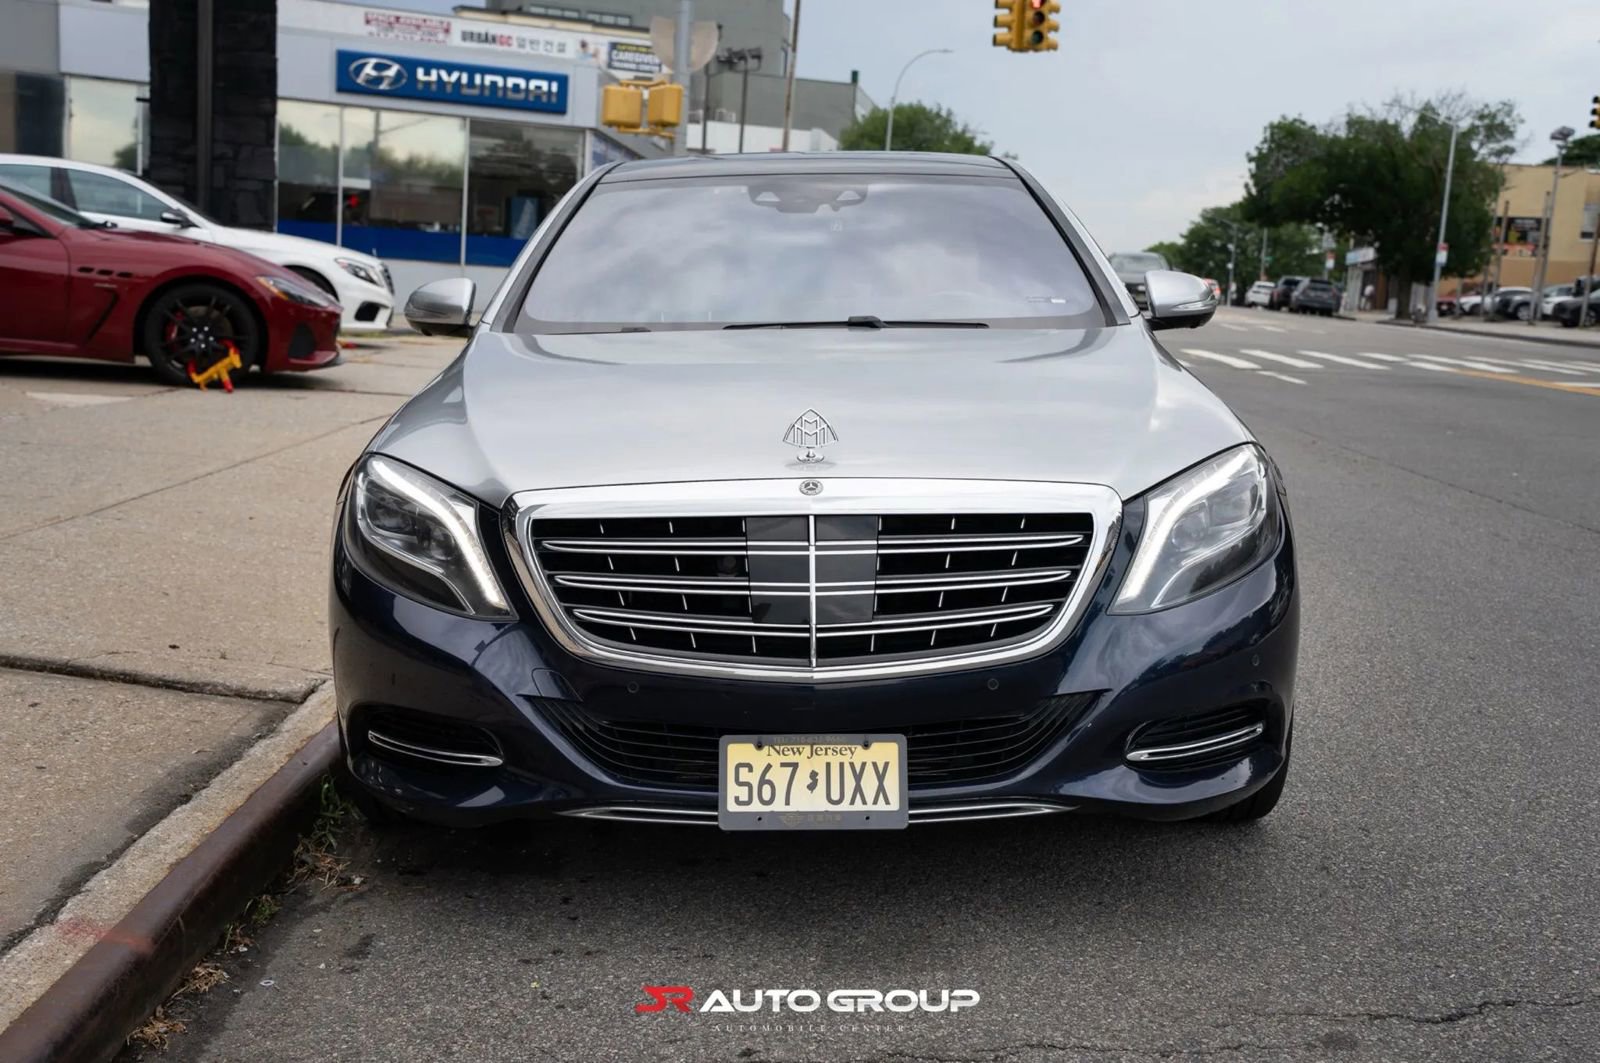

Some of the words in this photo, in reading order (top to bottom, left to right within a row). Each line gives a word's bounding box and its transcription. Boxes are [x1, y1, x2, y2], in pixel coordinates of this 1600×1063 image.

[416, 67, 558, 104] HYUNDAI
[766, 745, 805, 757] New
[807, 745, 858, 760] Jersey
[734, 761, 800, 806] S67
[825, 761, 891, 806] UXX
